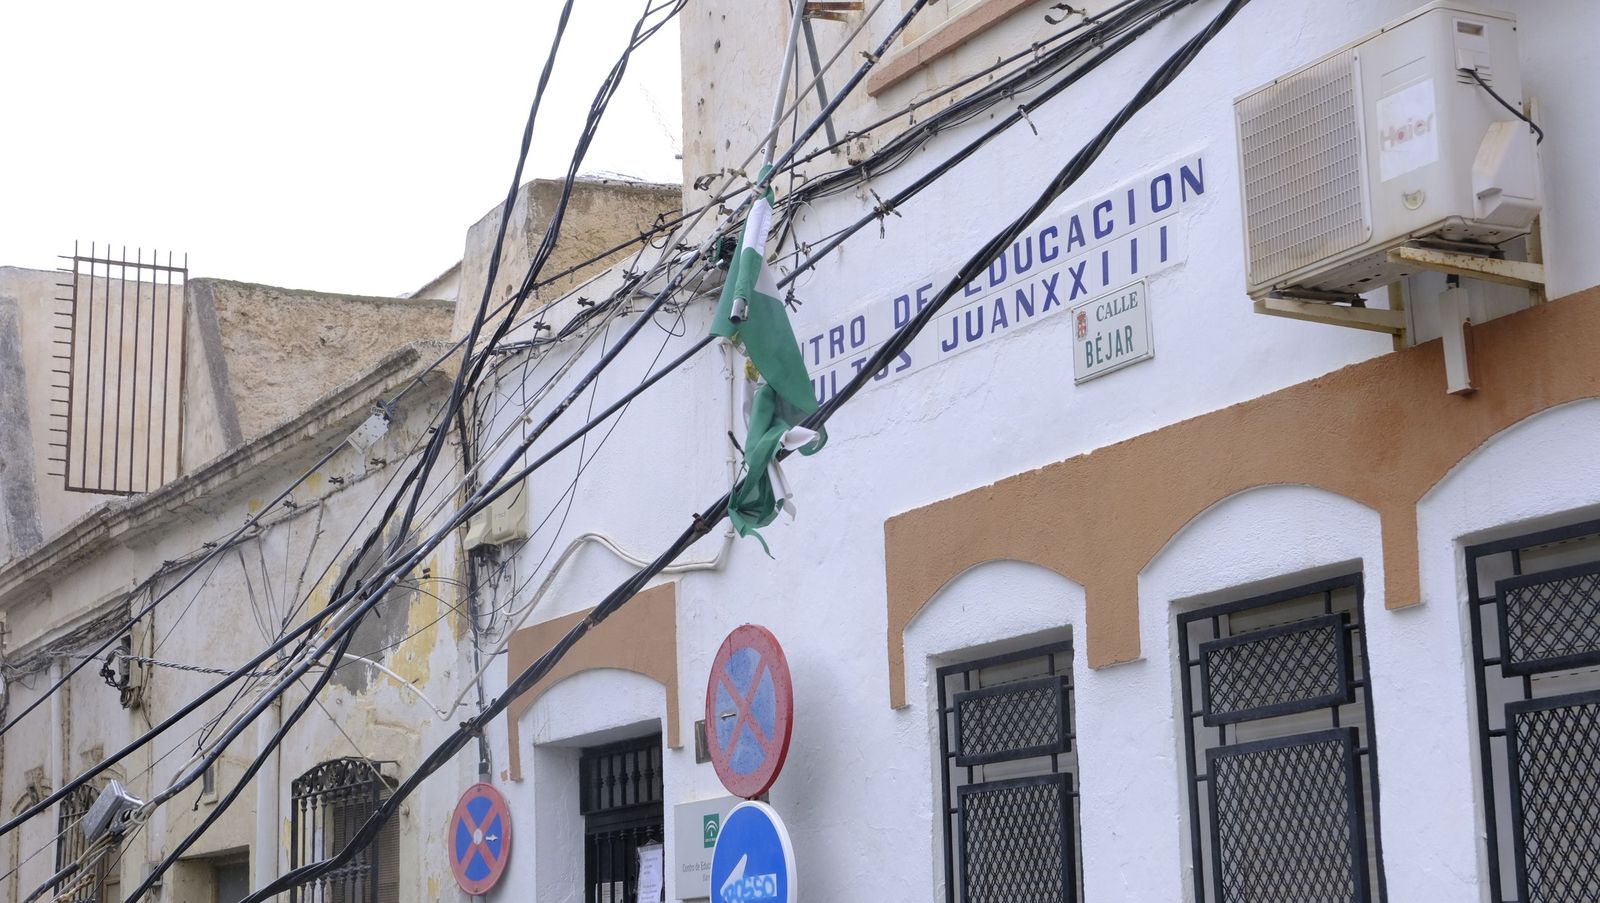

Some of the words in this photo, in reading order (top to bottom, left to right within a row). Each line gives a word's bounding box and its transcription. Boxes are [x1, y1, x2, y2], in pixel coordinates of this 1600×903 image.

[1381, 113, 1433, 151] Haier
[1096, 291, 1138, 322] CALLE
[1085, 325, 1133, 369] BÉJAR
